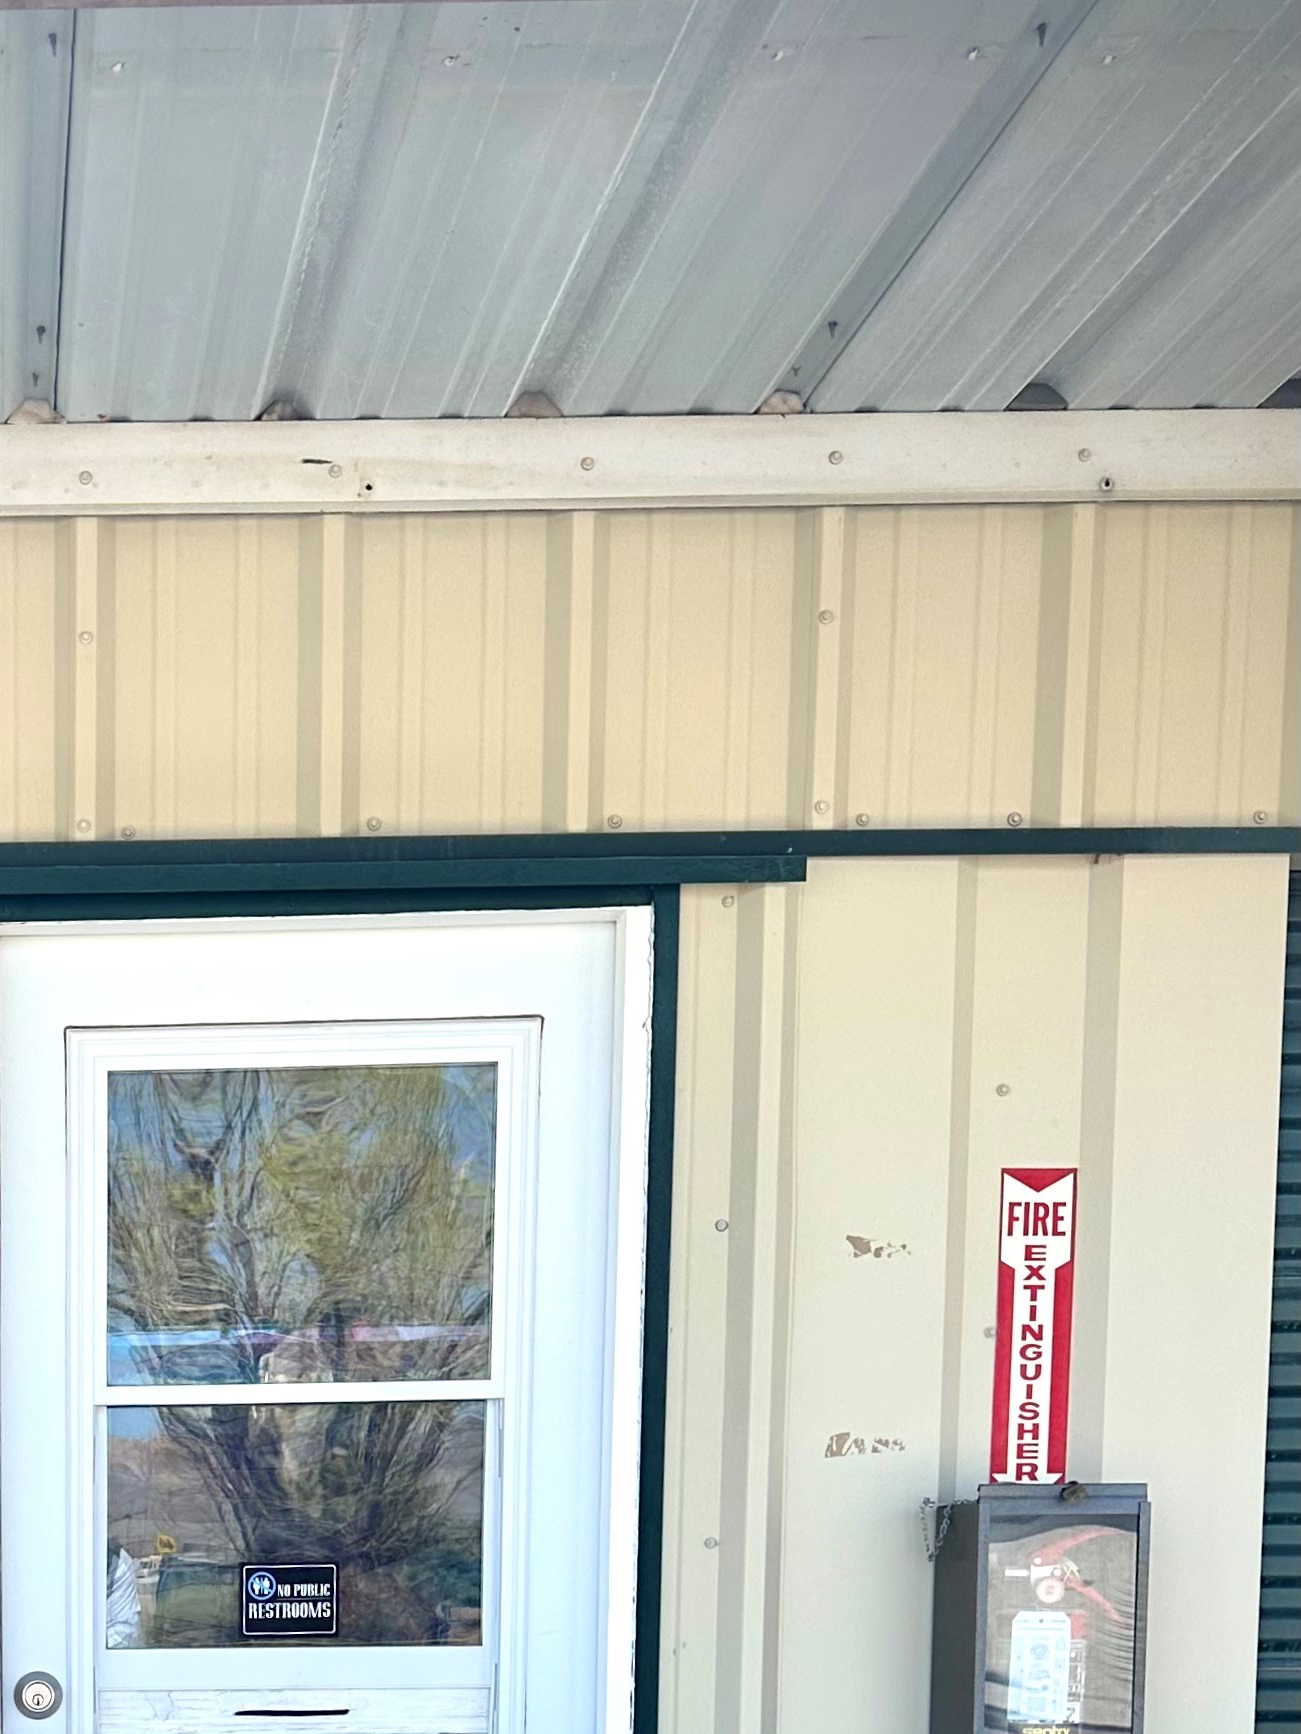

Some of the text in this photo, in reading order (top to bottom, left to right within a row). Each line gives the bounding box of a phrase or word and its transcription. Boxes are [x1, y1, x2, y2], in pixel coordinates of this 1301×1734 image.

[1006, 1201, 1067, 1237] FIRE
[1014, 1244, 1048, 1482] EXTINGUISHER
[277, 1583, 331, 1597] NO PUBLIC
[248, 1601, 332, 1619] RESTROOMS
